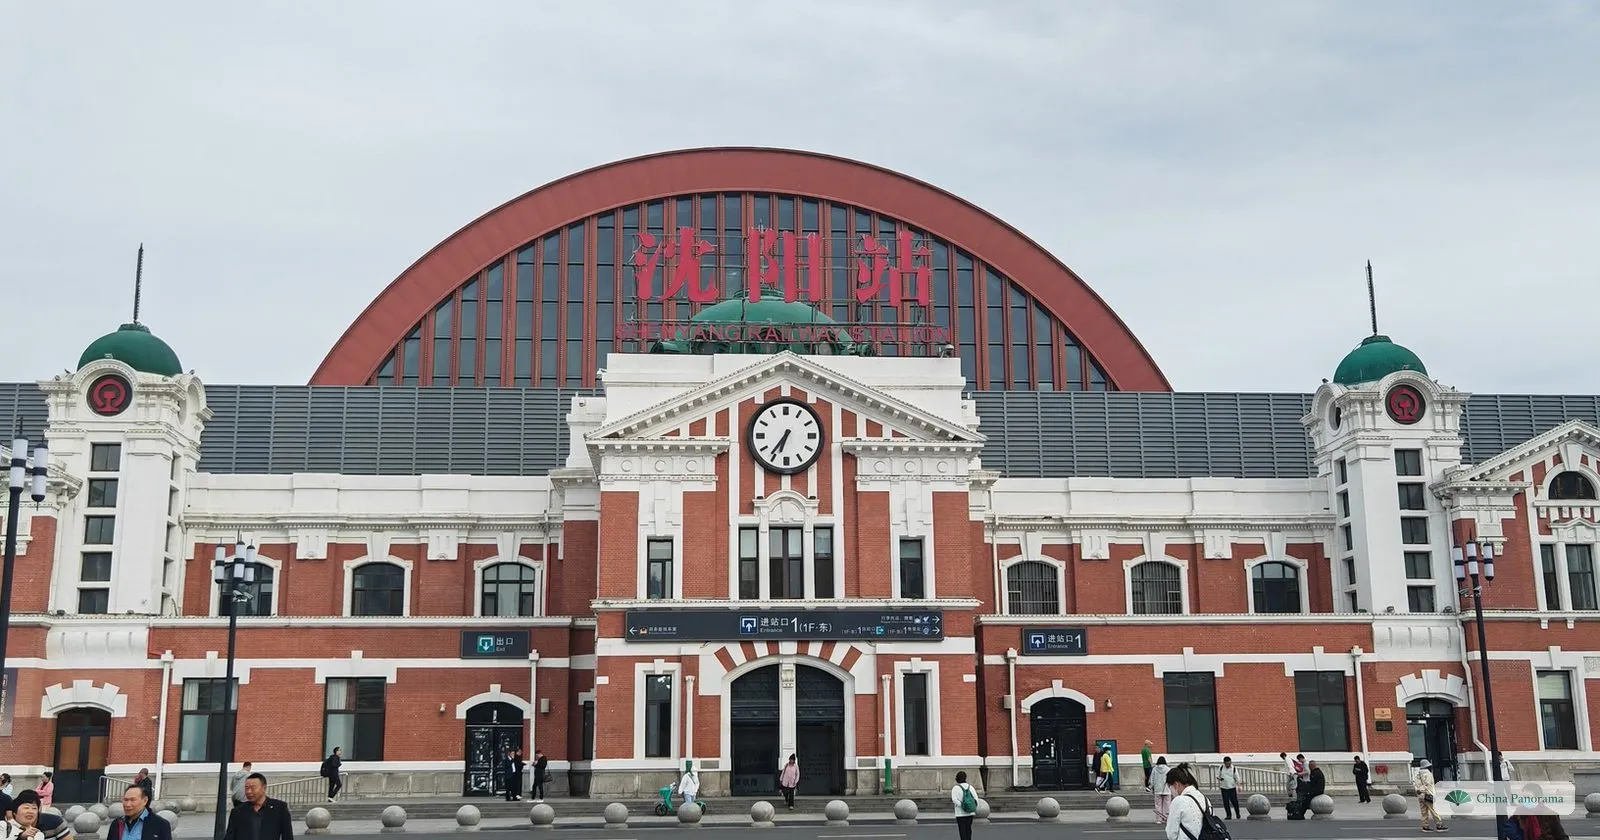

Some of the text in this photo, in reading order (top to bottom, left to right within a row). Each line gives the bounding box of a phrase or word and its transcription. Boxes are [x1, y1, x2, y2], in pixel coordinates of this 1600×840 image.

[635, 226, 931, 307] 沈阳站
[616, 323, 951, 343] SHENYANG RAILWAY STATION
[760, 617, 788, 626] 进站口
[791, 617, 798, 632] 1
[496, 637, 513, 645] 出口
[1047, 634, 1073, 643] 进站口
